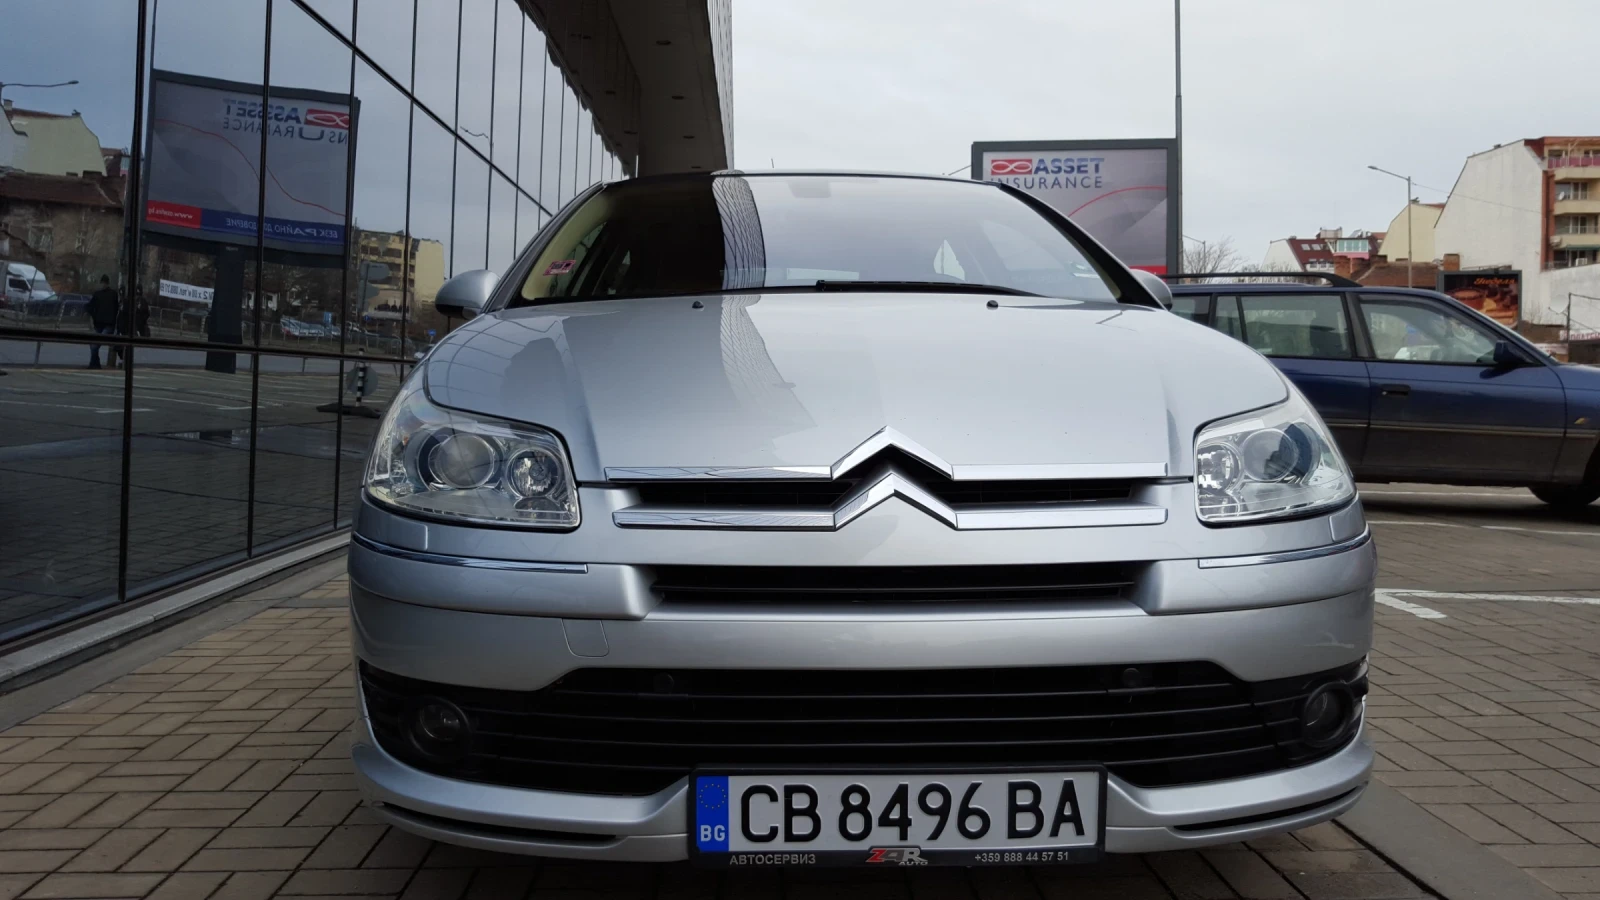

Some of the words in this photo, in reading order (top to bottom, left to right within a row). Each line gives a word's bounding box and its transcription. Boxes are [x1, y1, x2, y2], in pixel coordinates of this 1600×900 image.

[1033, 158, 1105, 175] ASSET
[741, 783, 822, 843] CB
[838, 781, 991, 842] 8496
[1007, 779, 1085, 839] BA
[700, 825, 726, 842] BG
[729, 854, 816, 865] АВТОСЕРВИЗ
[974, 852, 1000, 862] +359
[1003, 852, 1023, 862] 888
[1026, 852, 1039, 862] 44
[1041, 851, 1054, 861] 57
[1057, 851, 1069, 861] 51
